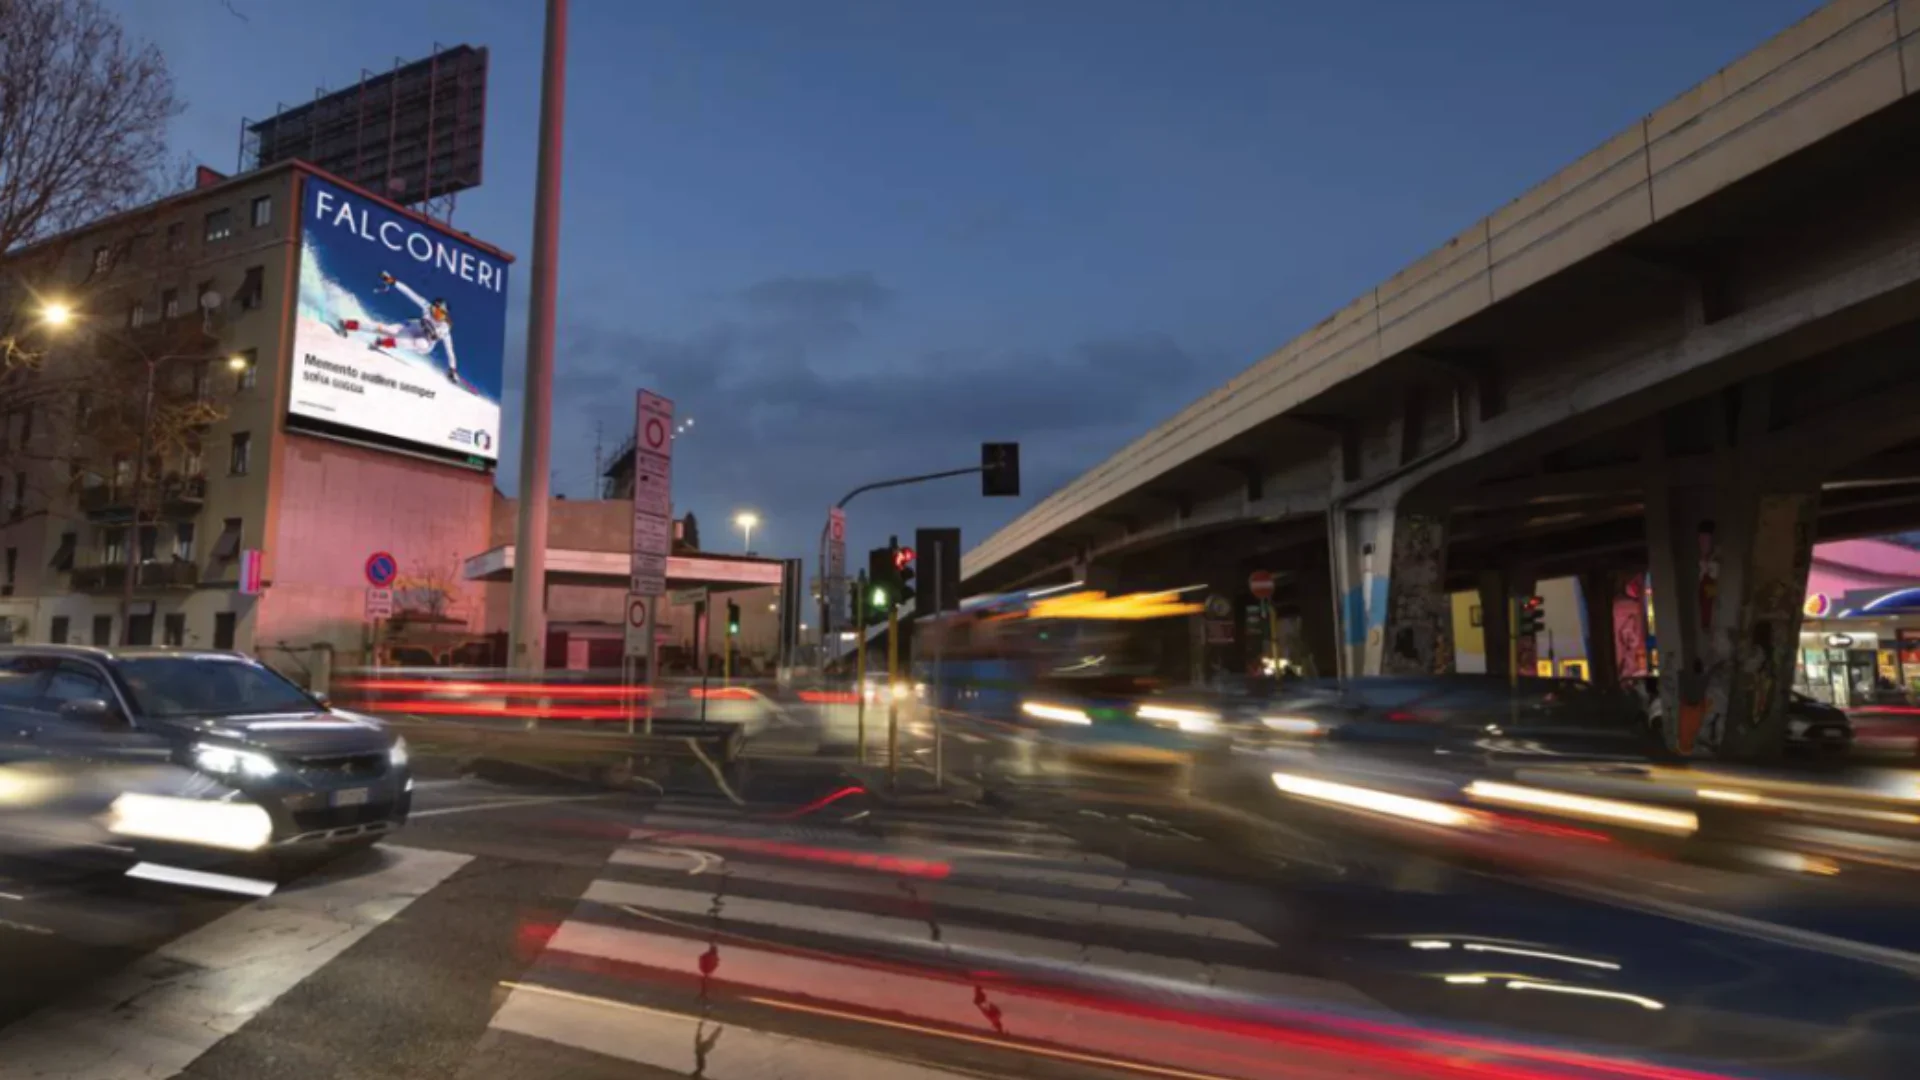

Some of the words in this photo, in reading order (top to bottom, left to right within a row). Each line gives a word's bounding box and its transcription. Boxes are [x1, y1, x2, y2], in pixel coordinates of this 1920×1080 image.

[316, 190, 502, 293] FALCONERI
[303, 353, 359, 379] Memento
[399, 382, 437, 399] semper
